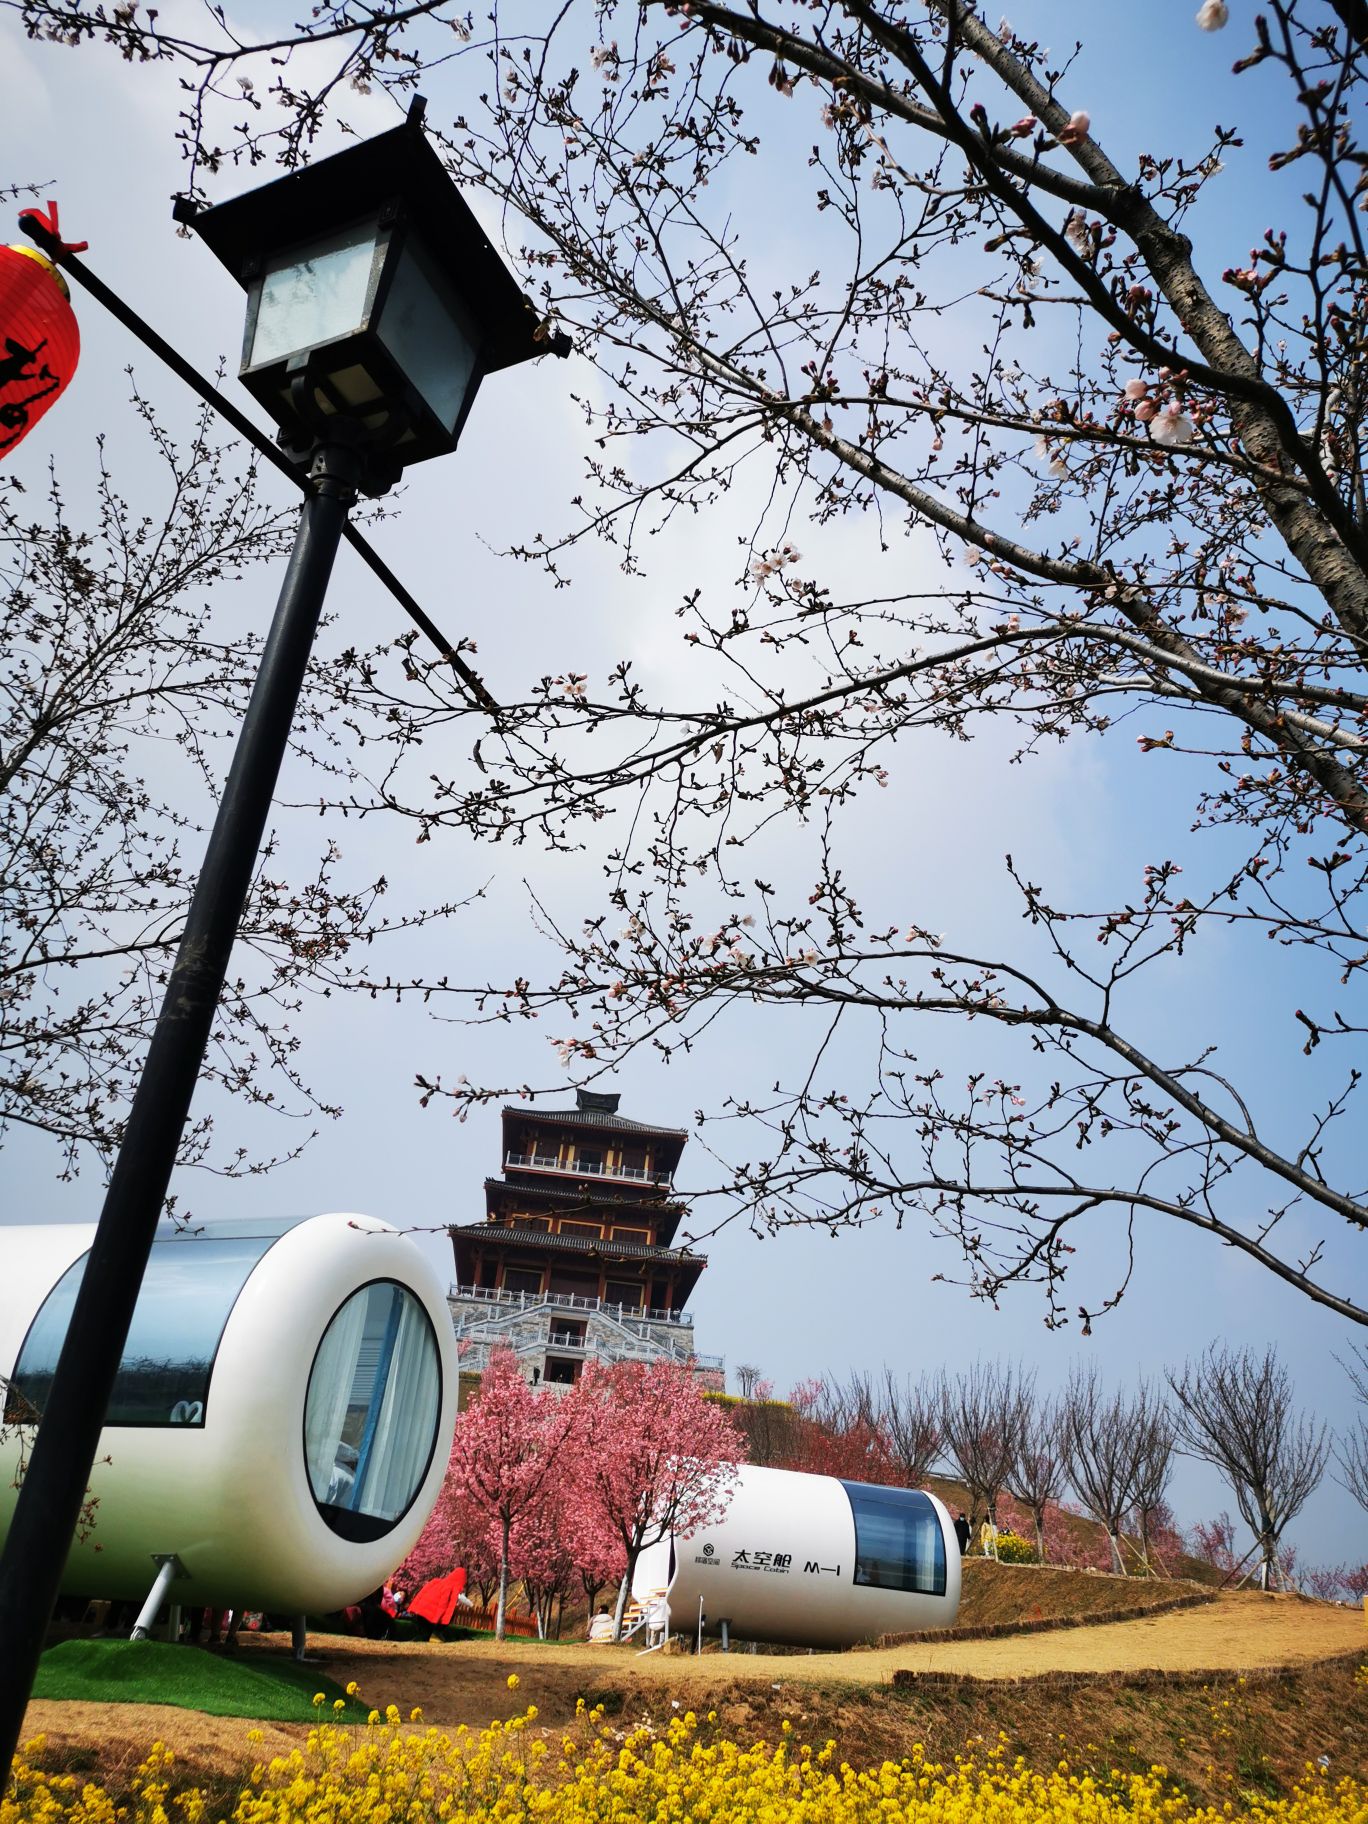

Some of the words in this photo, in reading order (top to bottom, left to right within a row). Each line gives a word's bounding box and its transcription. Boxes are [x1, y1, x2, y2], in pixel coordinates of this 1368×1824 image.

[733, 1549, 792, 1568] 太空舱
[731, 1562, 760, 1571] Space
[764, 1566, 790, 1574] Cabin
